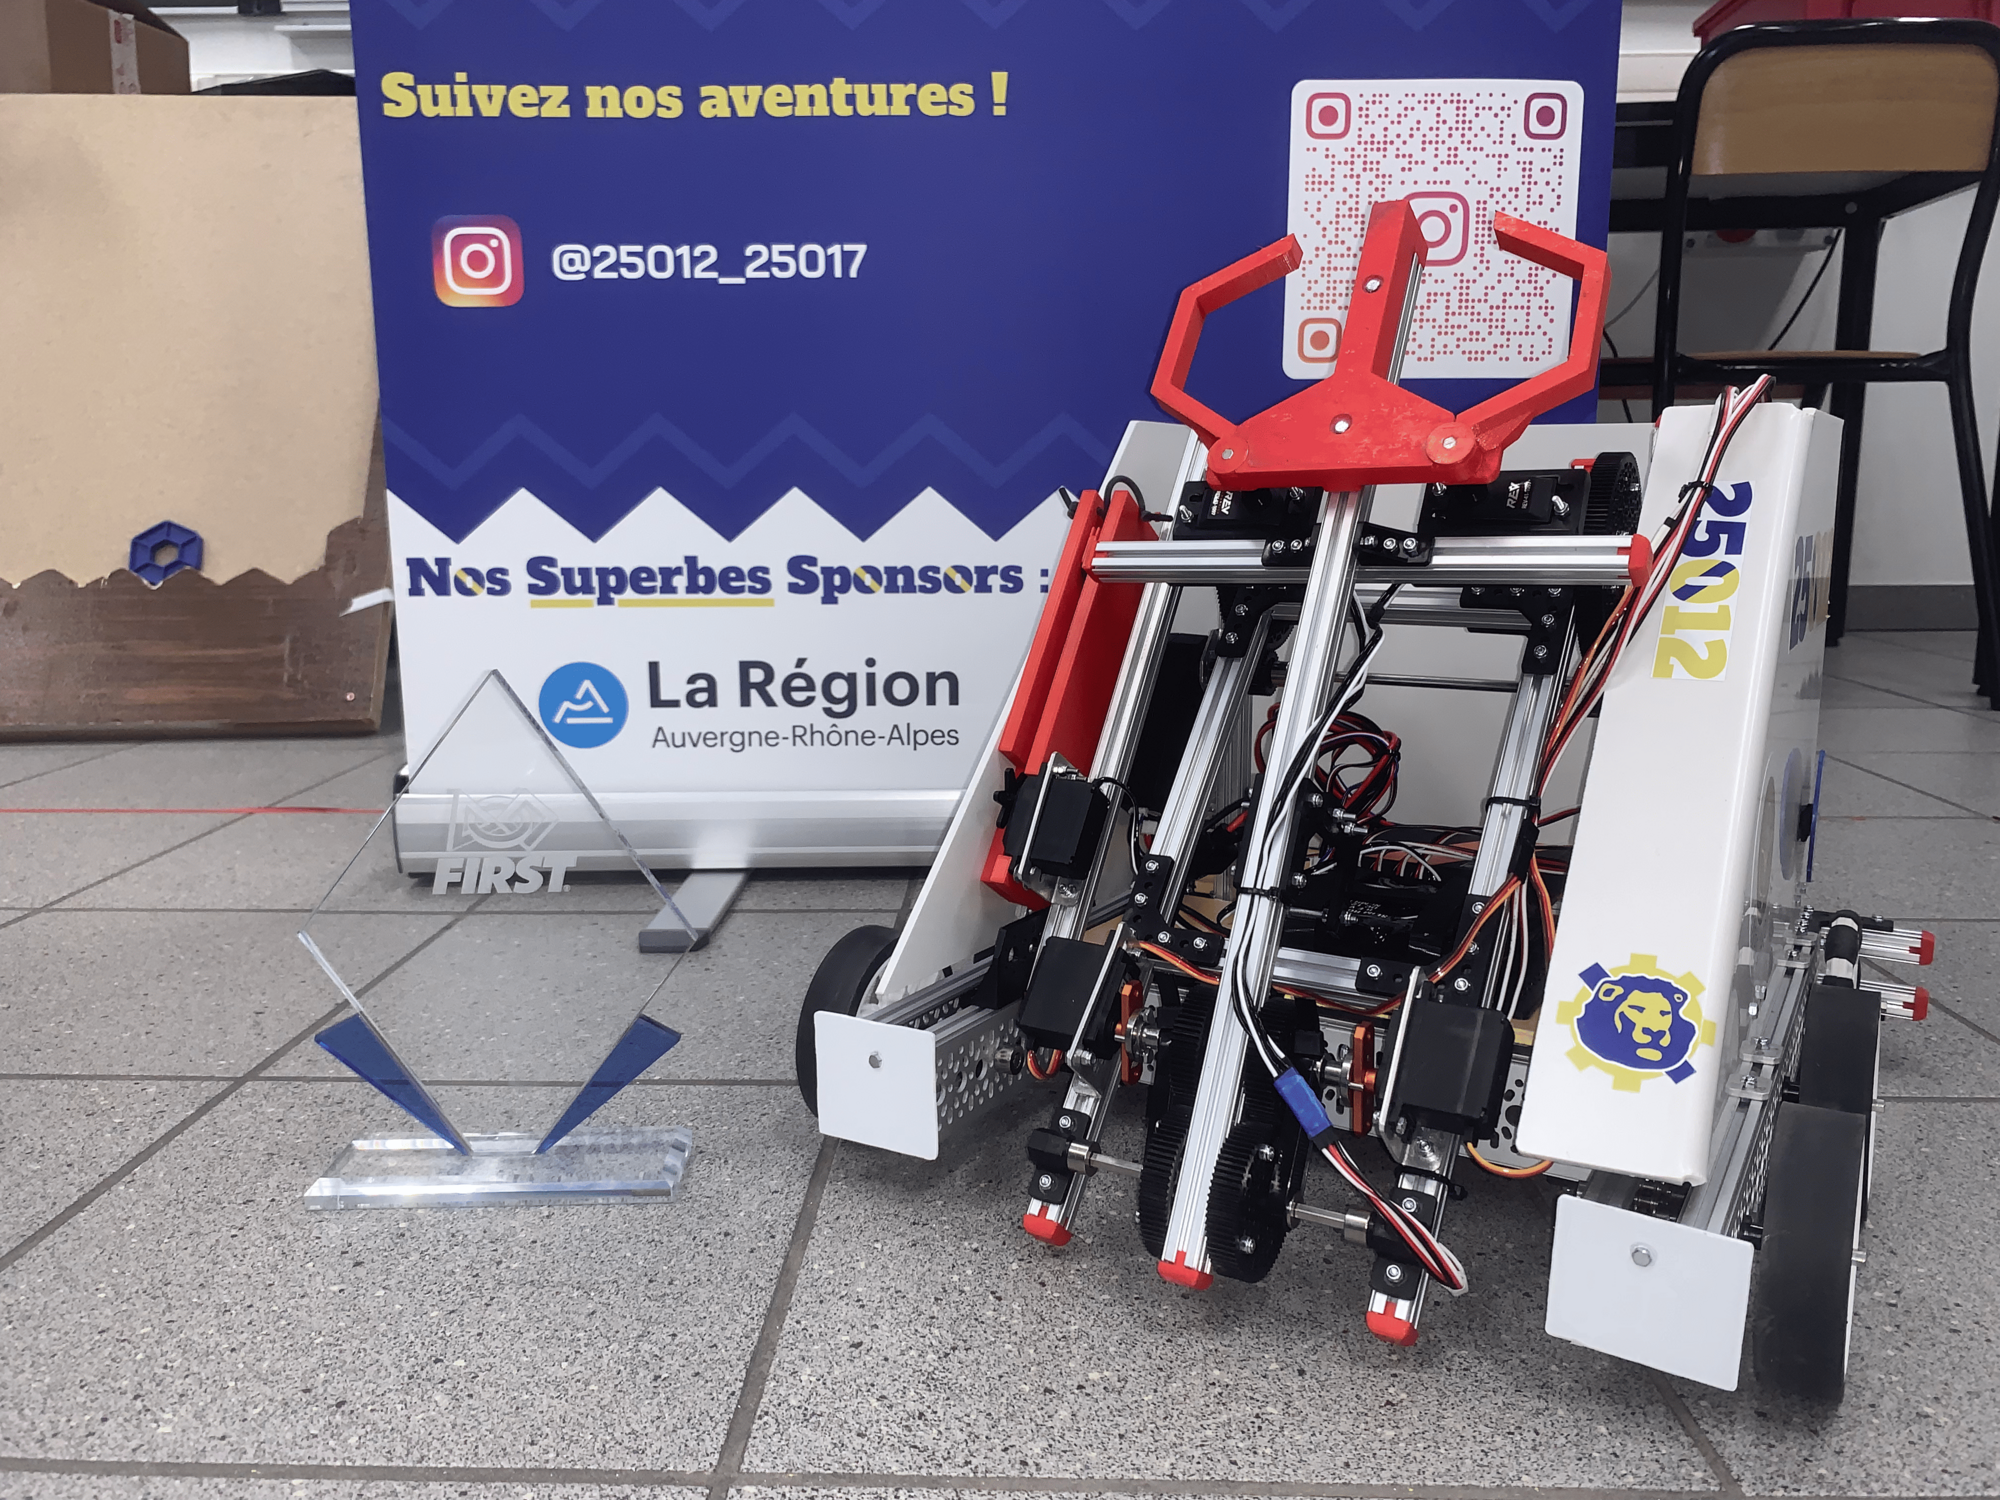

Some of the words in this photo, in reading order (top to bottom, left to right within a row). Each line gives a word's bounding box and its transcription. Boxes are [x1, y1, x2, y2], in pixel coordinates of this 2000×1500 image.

[381, 72, 571, 118] Suivez
[585, 85, 684, 119] nos
[699, 77, 975, 119] aventures
[991, 72, 1009, 116] !
[551, 243, 868, 285] @25012_25017
[1221, 491, 1233, 515] REV
[1506, 482, 1520, 508] REV
[406, 557, 512, 598] Nos
[525, 555, 773, 606] Superbes
[786, 554, 1024, 605] Sponsors
[1652, 481, 1753, 680] 25012
[648, 661, 718, 708] La
[738, 657, 960, 719] Région
[652, 721, 960, 753] Auvergne-Rhône-Alpes
[432, 855, 577, 895] FIRST
